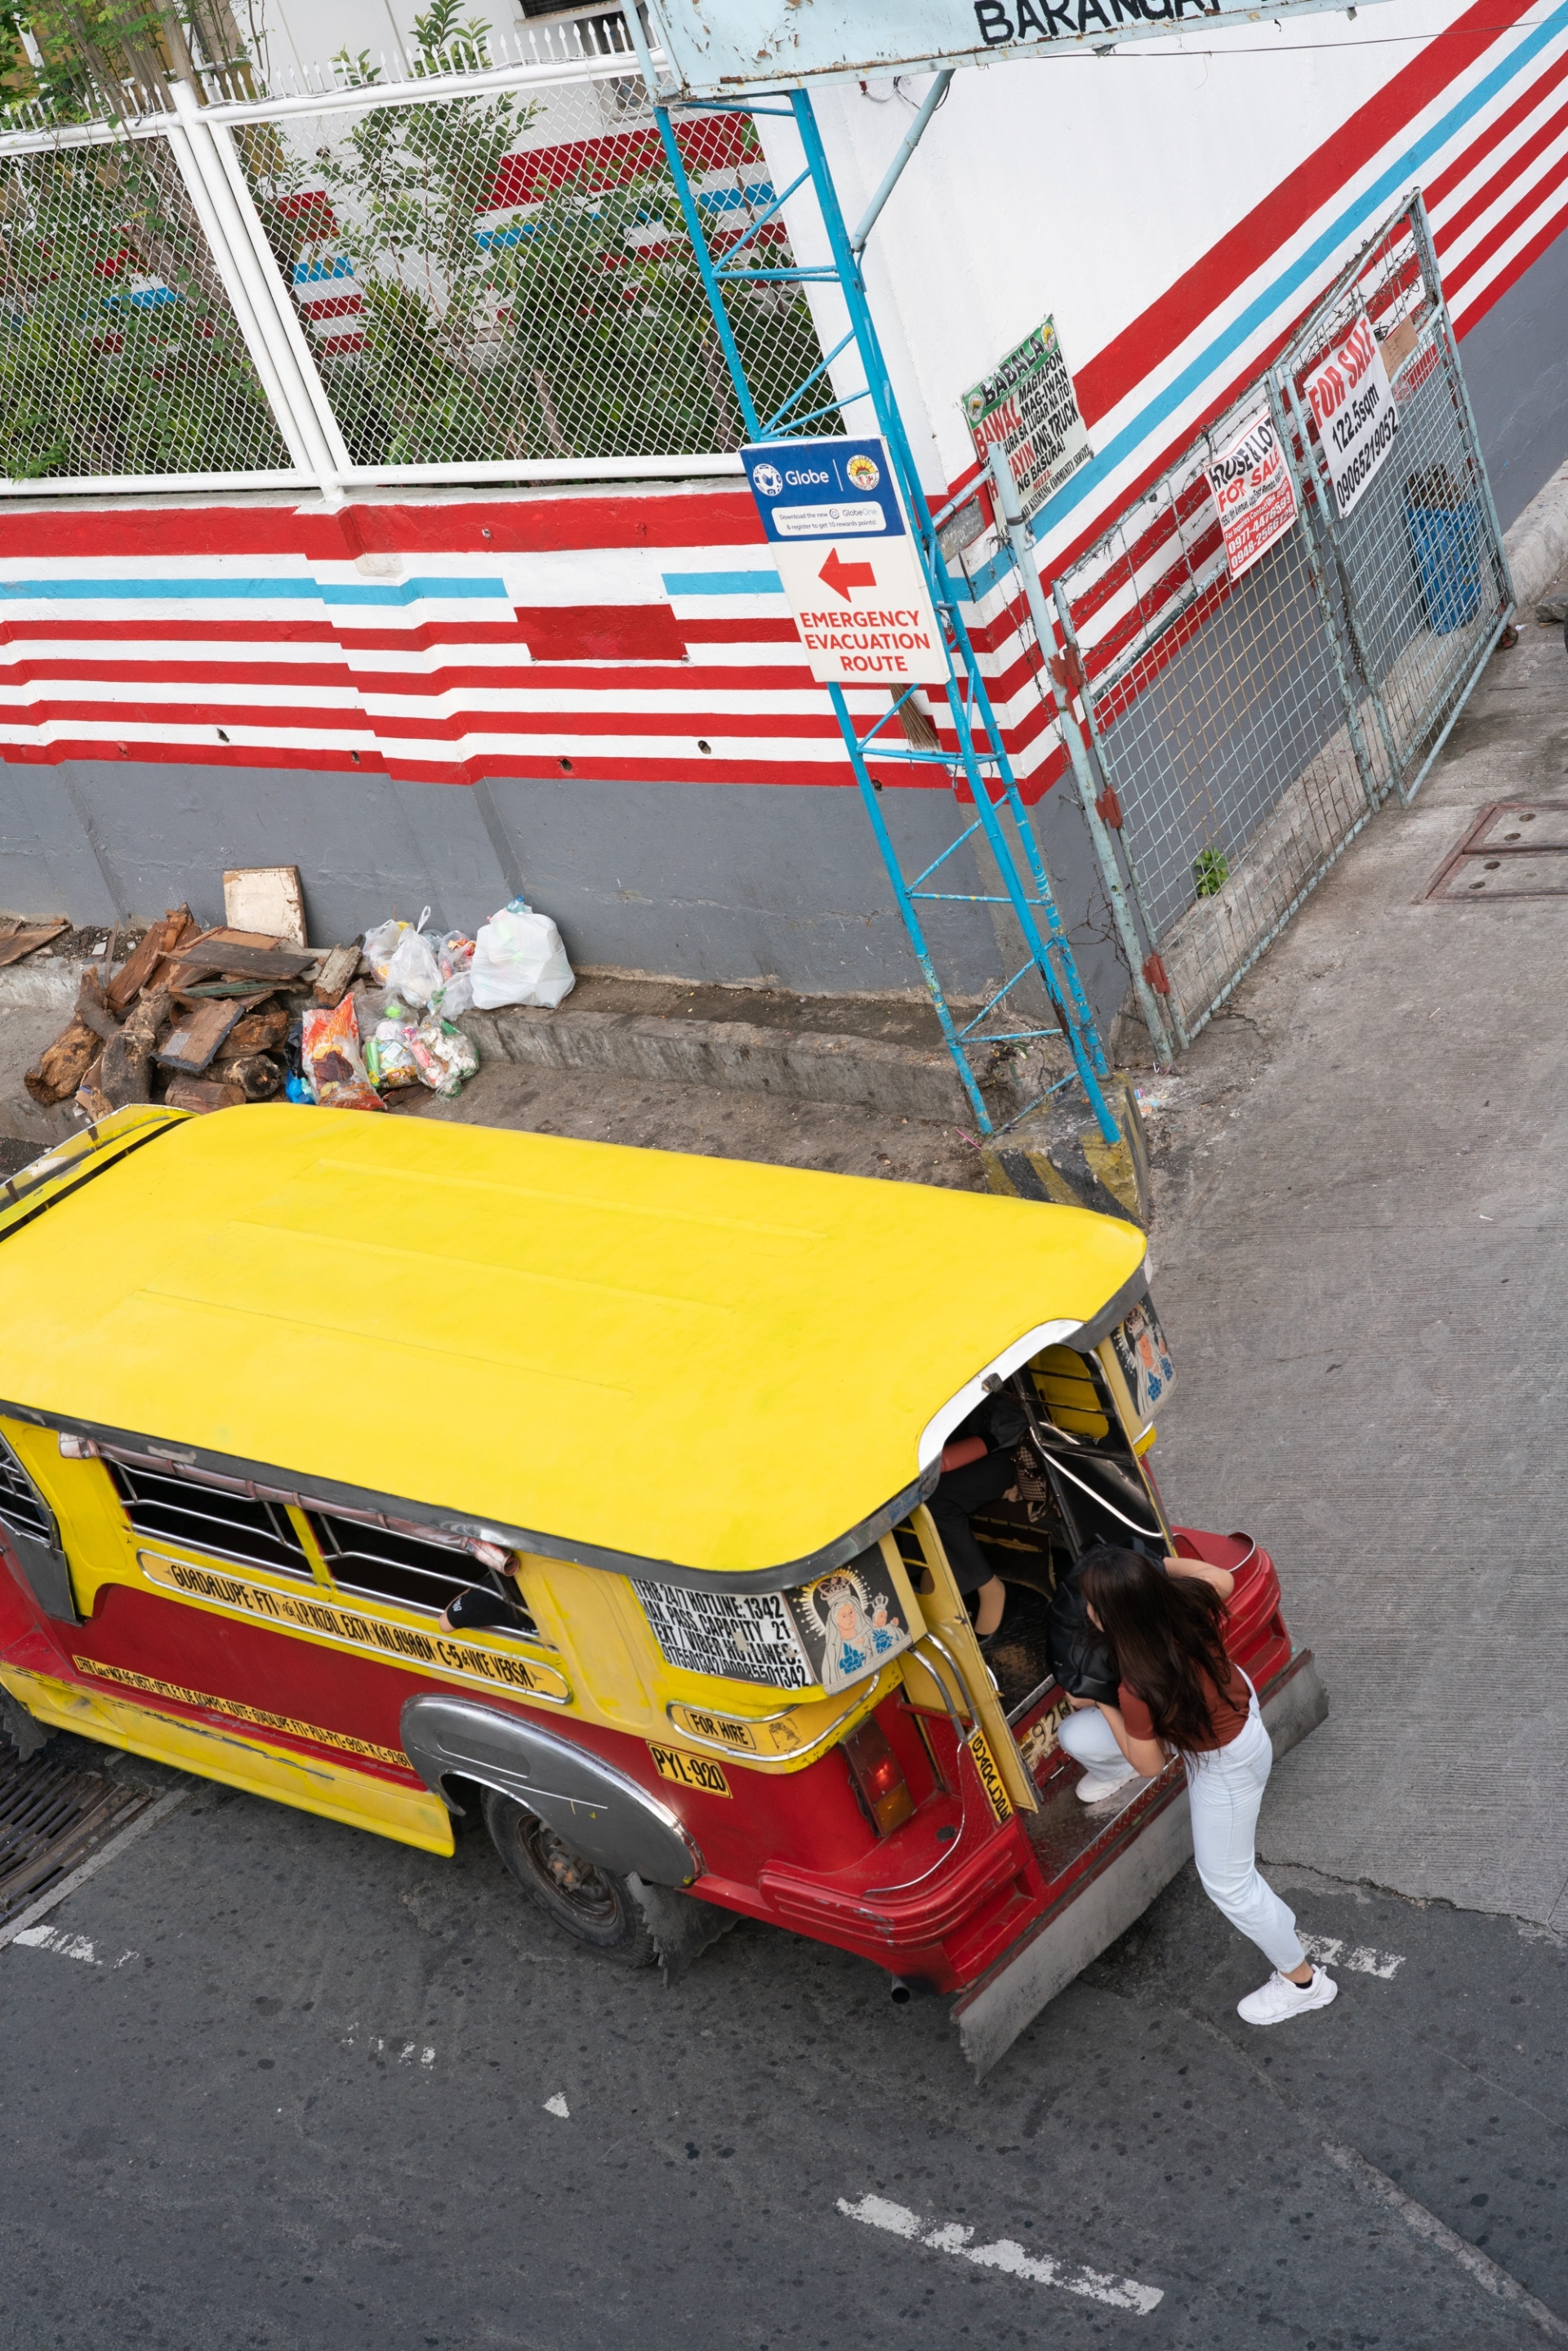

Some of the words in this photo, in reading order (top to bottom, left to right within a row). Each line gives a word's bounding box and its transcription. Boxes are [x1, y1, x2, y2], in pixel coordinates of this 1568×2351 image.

[973, 0, 1222, 45] BARAN
[979, 336, 1045, 407] BABALA
[1018, 349, 1064, 404] MAGTAPON
[1020, 366, 1067, 421] MAG-IWAN
[1308, 365, 1346, 430] FOR
[1337, 318, 1376, 390] SALE
[973, 395, 1022, 461] BAWAL
[1018, 423, 1029, 441] SA
[1027, 401, 1049, 433] LUGAR
[1049, 393, 1059, 412] NA
[1058, 380, 1071, 403] ITO!
[1031, 424, 1054, 459] ANG
[1048, 397, 1079, 440] TRUCK
[1332, 382, 1380, 453] 122.5sqm
[1250, 417, 1272, 455] LOT
[1336, 406, 1399, 509] 09065219052
[785, 470, 829, 486] Globe
[1017, 473, 1031, 495] NG
[1030, 437, 1066, 483] BASURA!
[1050, 460, 1075, 491] COMMUNITY
[1073, 443, 1090, 468] SERVICE
[1218, 478, 1246, 513] FOR
[1250, 443, 1281, 487] SALE
[779, 512, 806, 520] Download
[843, 508, 877, 517] GlobeOne
[791, 523, 811, 531] register
[858, 519, 876, 528] points!
[800, 610, 919, 628] EMERGENCY
[804, 633, 930, 649] EVACUATION
[840, 656, 908, 671] ROUTE
[632, 1578, 664, 1602] TFRB
[659, 1584, 689, 1610] 24/7
[685, 1591, 746, 1619] HOTLINE:
[744, 1596, 784, 1620] 1342
[171, 1565, 253, 1609] GUADALUPE
[252, 1589, 279, 1617] FTI
[307, 1605, 345, 1636] RIZAL
[371, 1622, 436, 1661] KALAYAAN
[437, 1641, 463, 1669] C-5
[465, 1649, 495, 1678] VICE
[489, 1655, 534, 1688] VERSA
[666, 1605, 702, 1633] PASS.
[698, 1614, 764, 1642] CAPACITY
[771, 1620, 791, 1640] 21
[684, 1629, 726, 1658] VIBER
[252, 1708, 293, 1732] GUADALUPE
[690, 1713, 719, 1737] FOR
[717, 1721, 749, 1745] HIRE
[972, 1736, 1012, 1823] GUADALUPE
